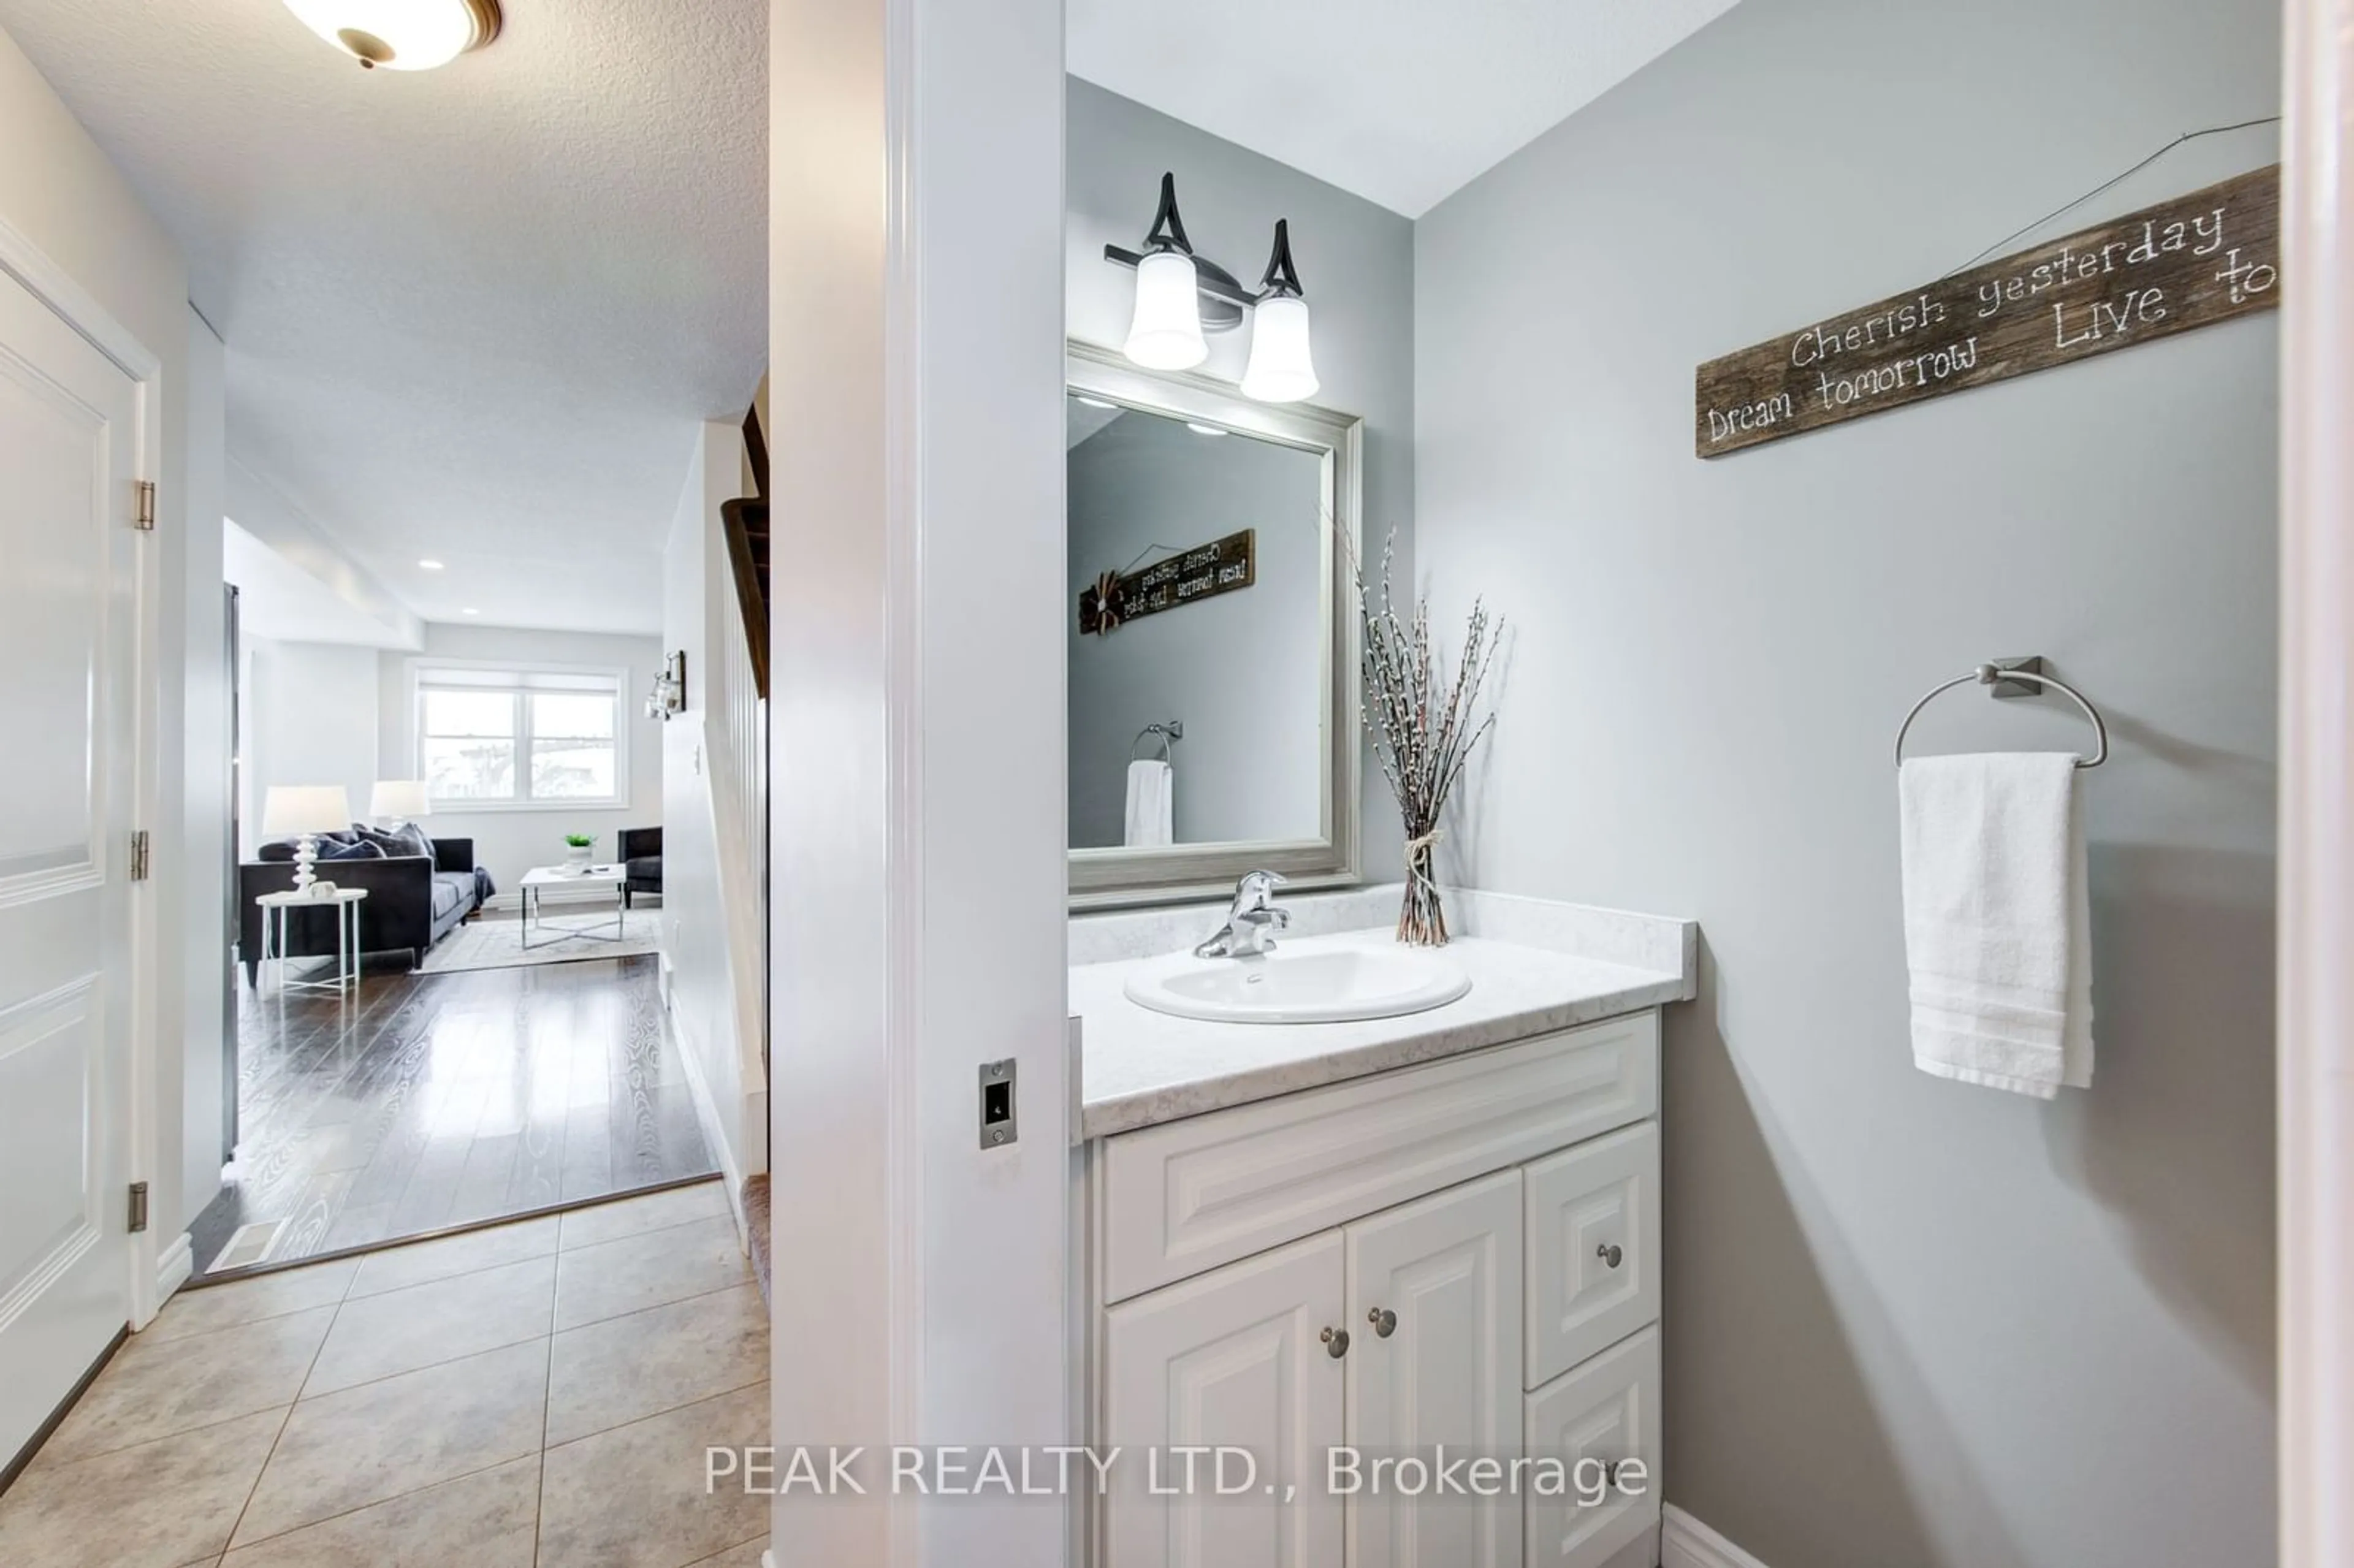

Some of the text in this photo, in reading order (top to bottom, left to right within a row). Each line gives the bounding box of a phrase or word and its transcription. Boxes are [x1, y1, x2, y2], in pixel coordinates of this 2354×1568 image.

[1708, 392, 1793, 443] Dream
[1815, 337, 1978, 411] tomorrow
[2215, 247, 2277, 304] to
[1792, 207, 2226, 367] Cherish yesterday
